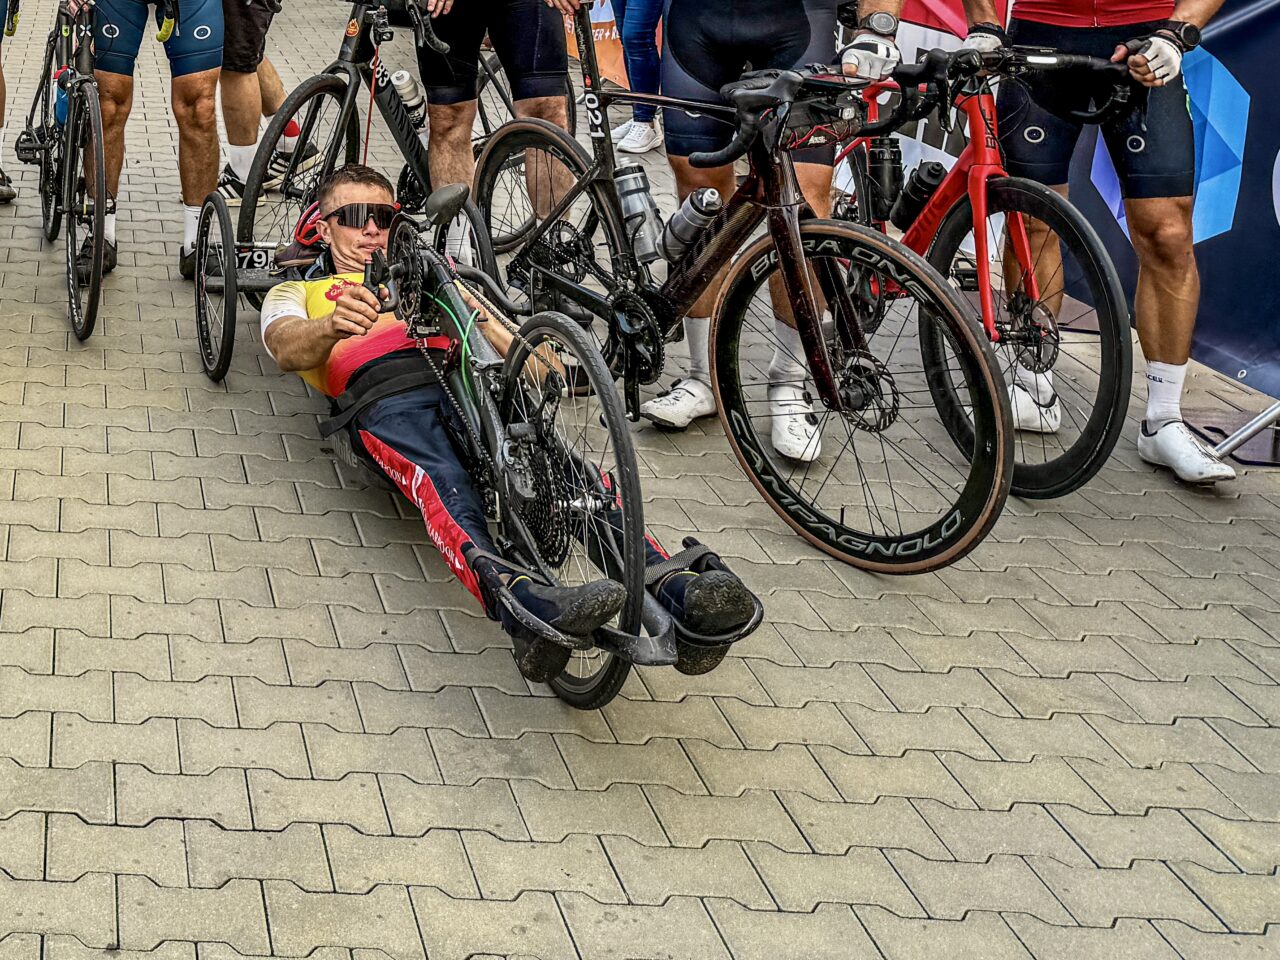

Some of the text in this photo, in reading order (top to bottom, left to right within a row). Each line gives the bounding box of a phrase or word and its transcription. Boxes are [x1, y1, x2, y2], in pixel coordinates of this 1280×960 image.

[585, 93, 606, 138] 021
[236, 249, 268, 269] 79
[730, 409, 962, 557] CAMPAGNOLO
